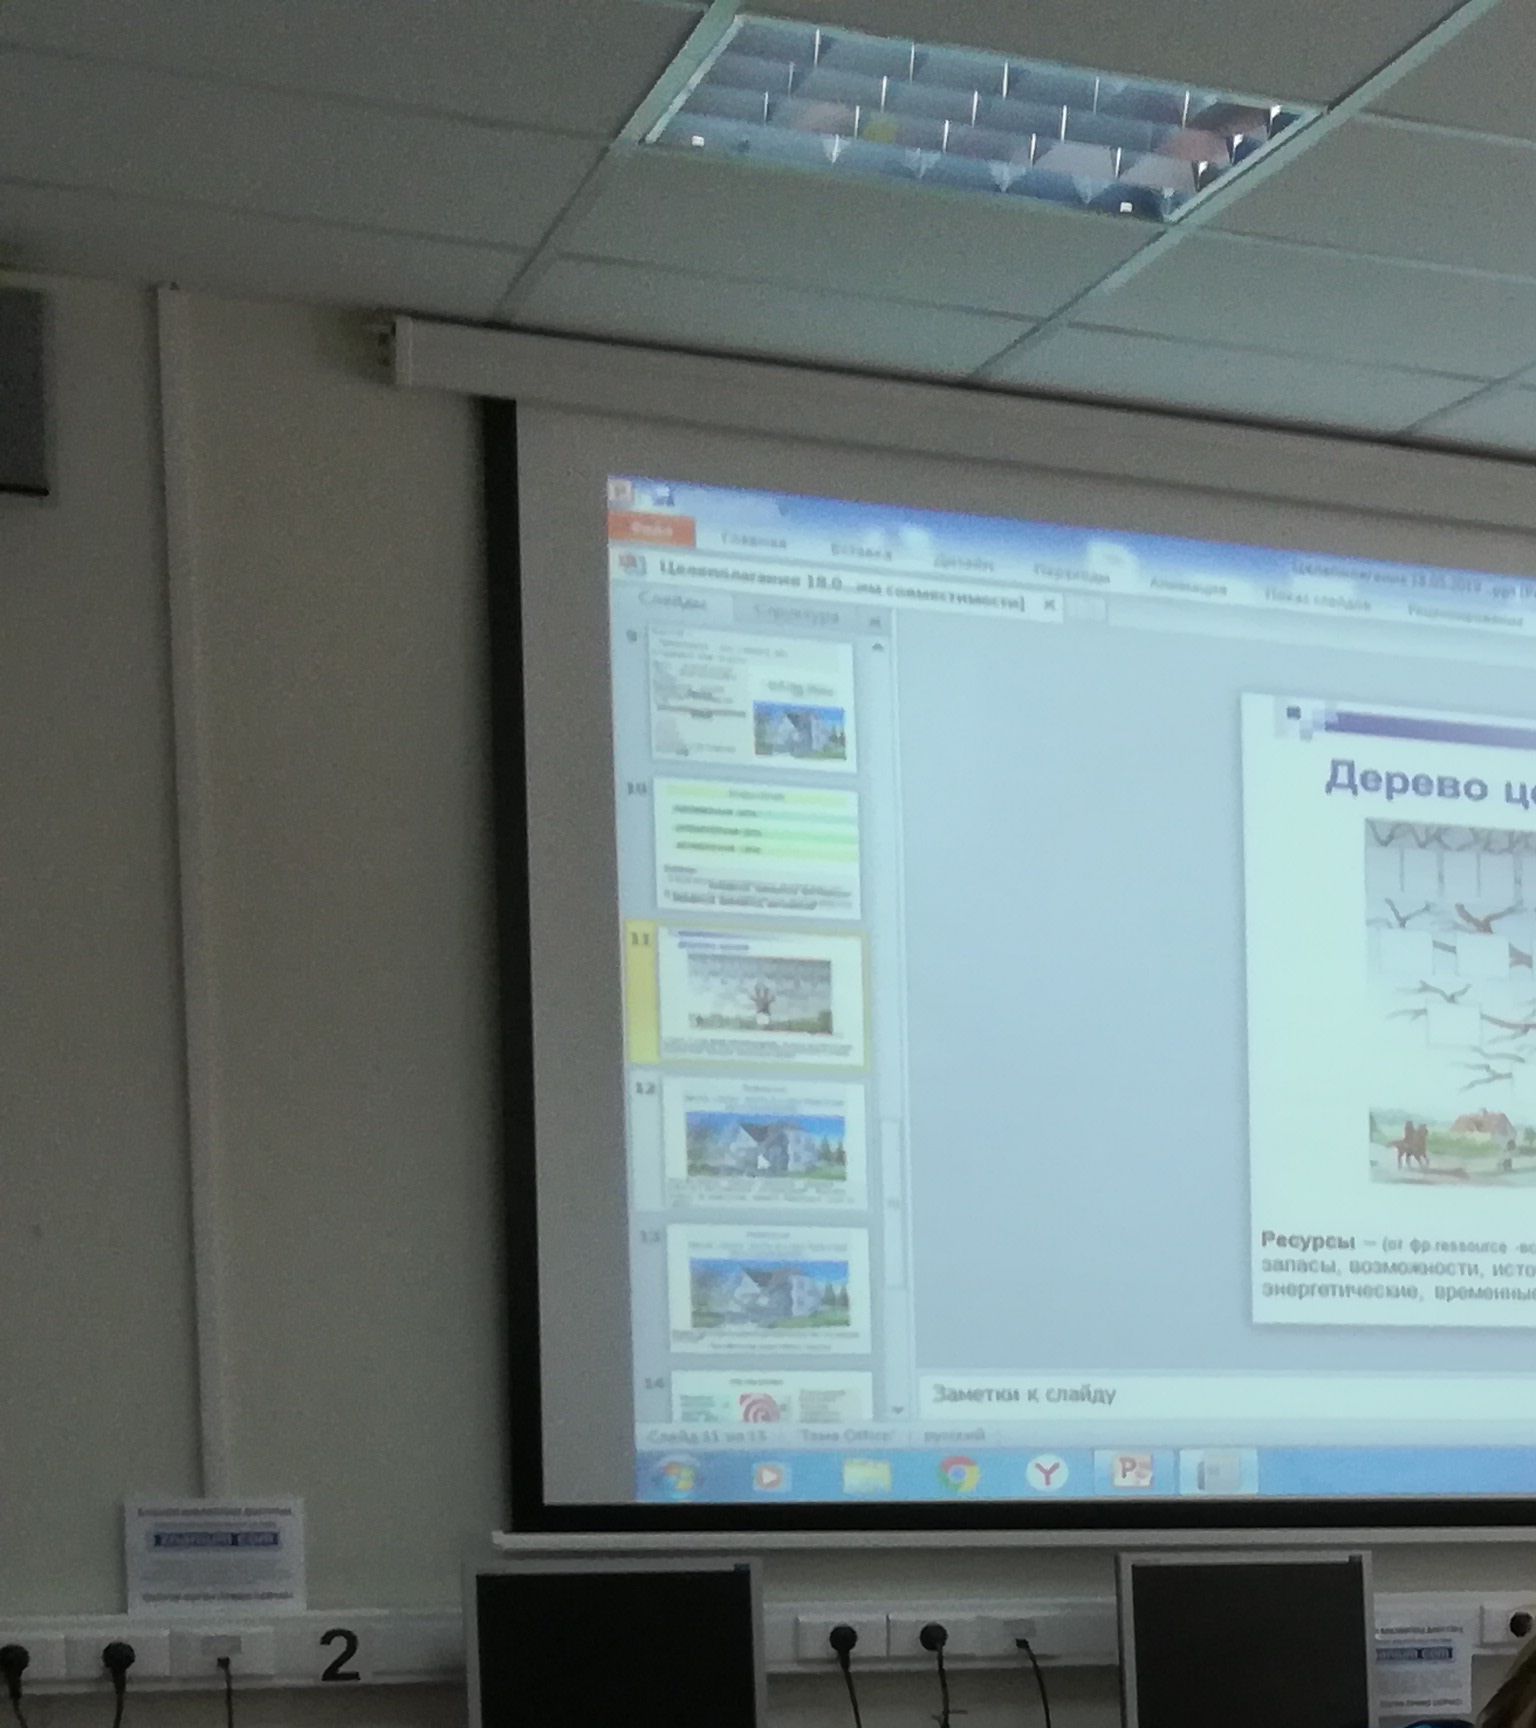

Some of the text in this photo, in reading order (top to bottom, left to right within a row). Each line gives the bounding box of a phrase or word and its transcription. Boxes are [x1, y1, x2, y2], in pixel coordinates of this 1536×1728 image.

[1325, 758, 1490, 801] Дерево
[1261, 1230, 1356, 1251] Ресурсы
[1262, 1258, 1342, 1276] запасы,
[1349, 1260, 1484, 1278] возможности,
[1262, 1282, 1424, 1301] энергетические,
[932, 1383, 1117, 1406] Заметки к слайду
[319, 1629, 361, 1682] 2
